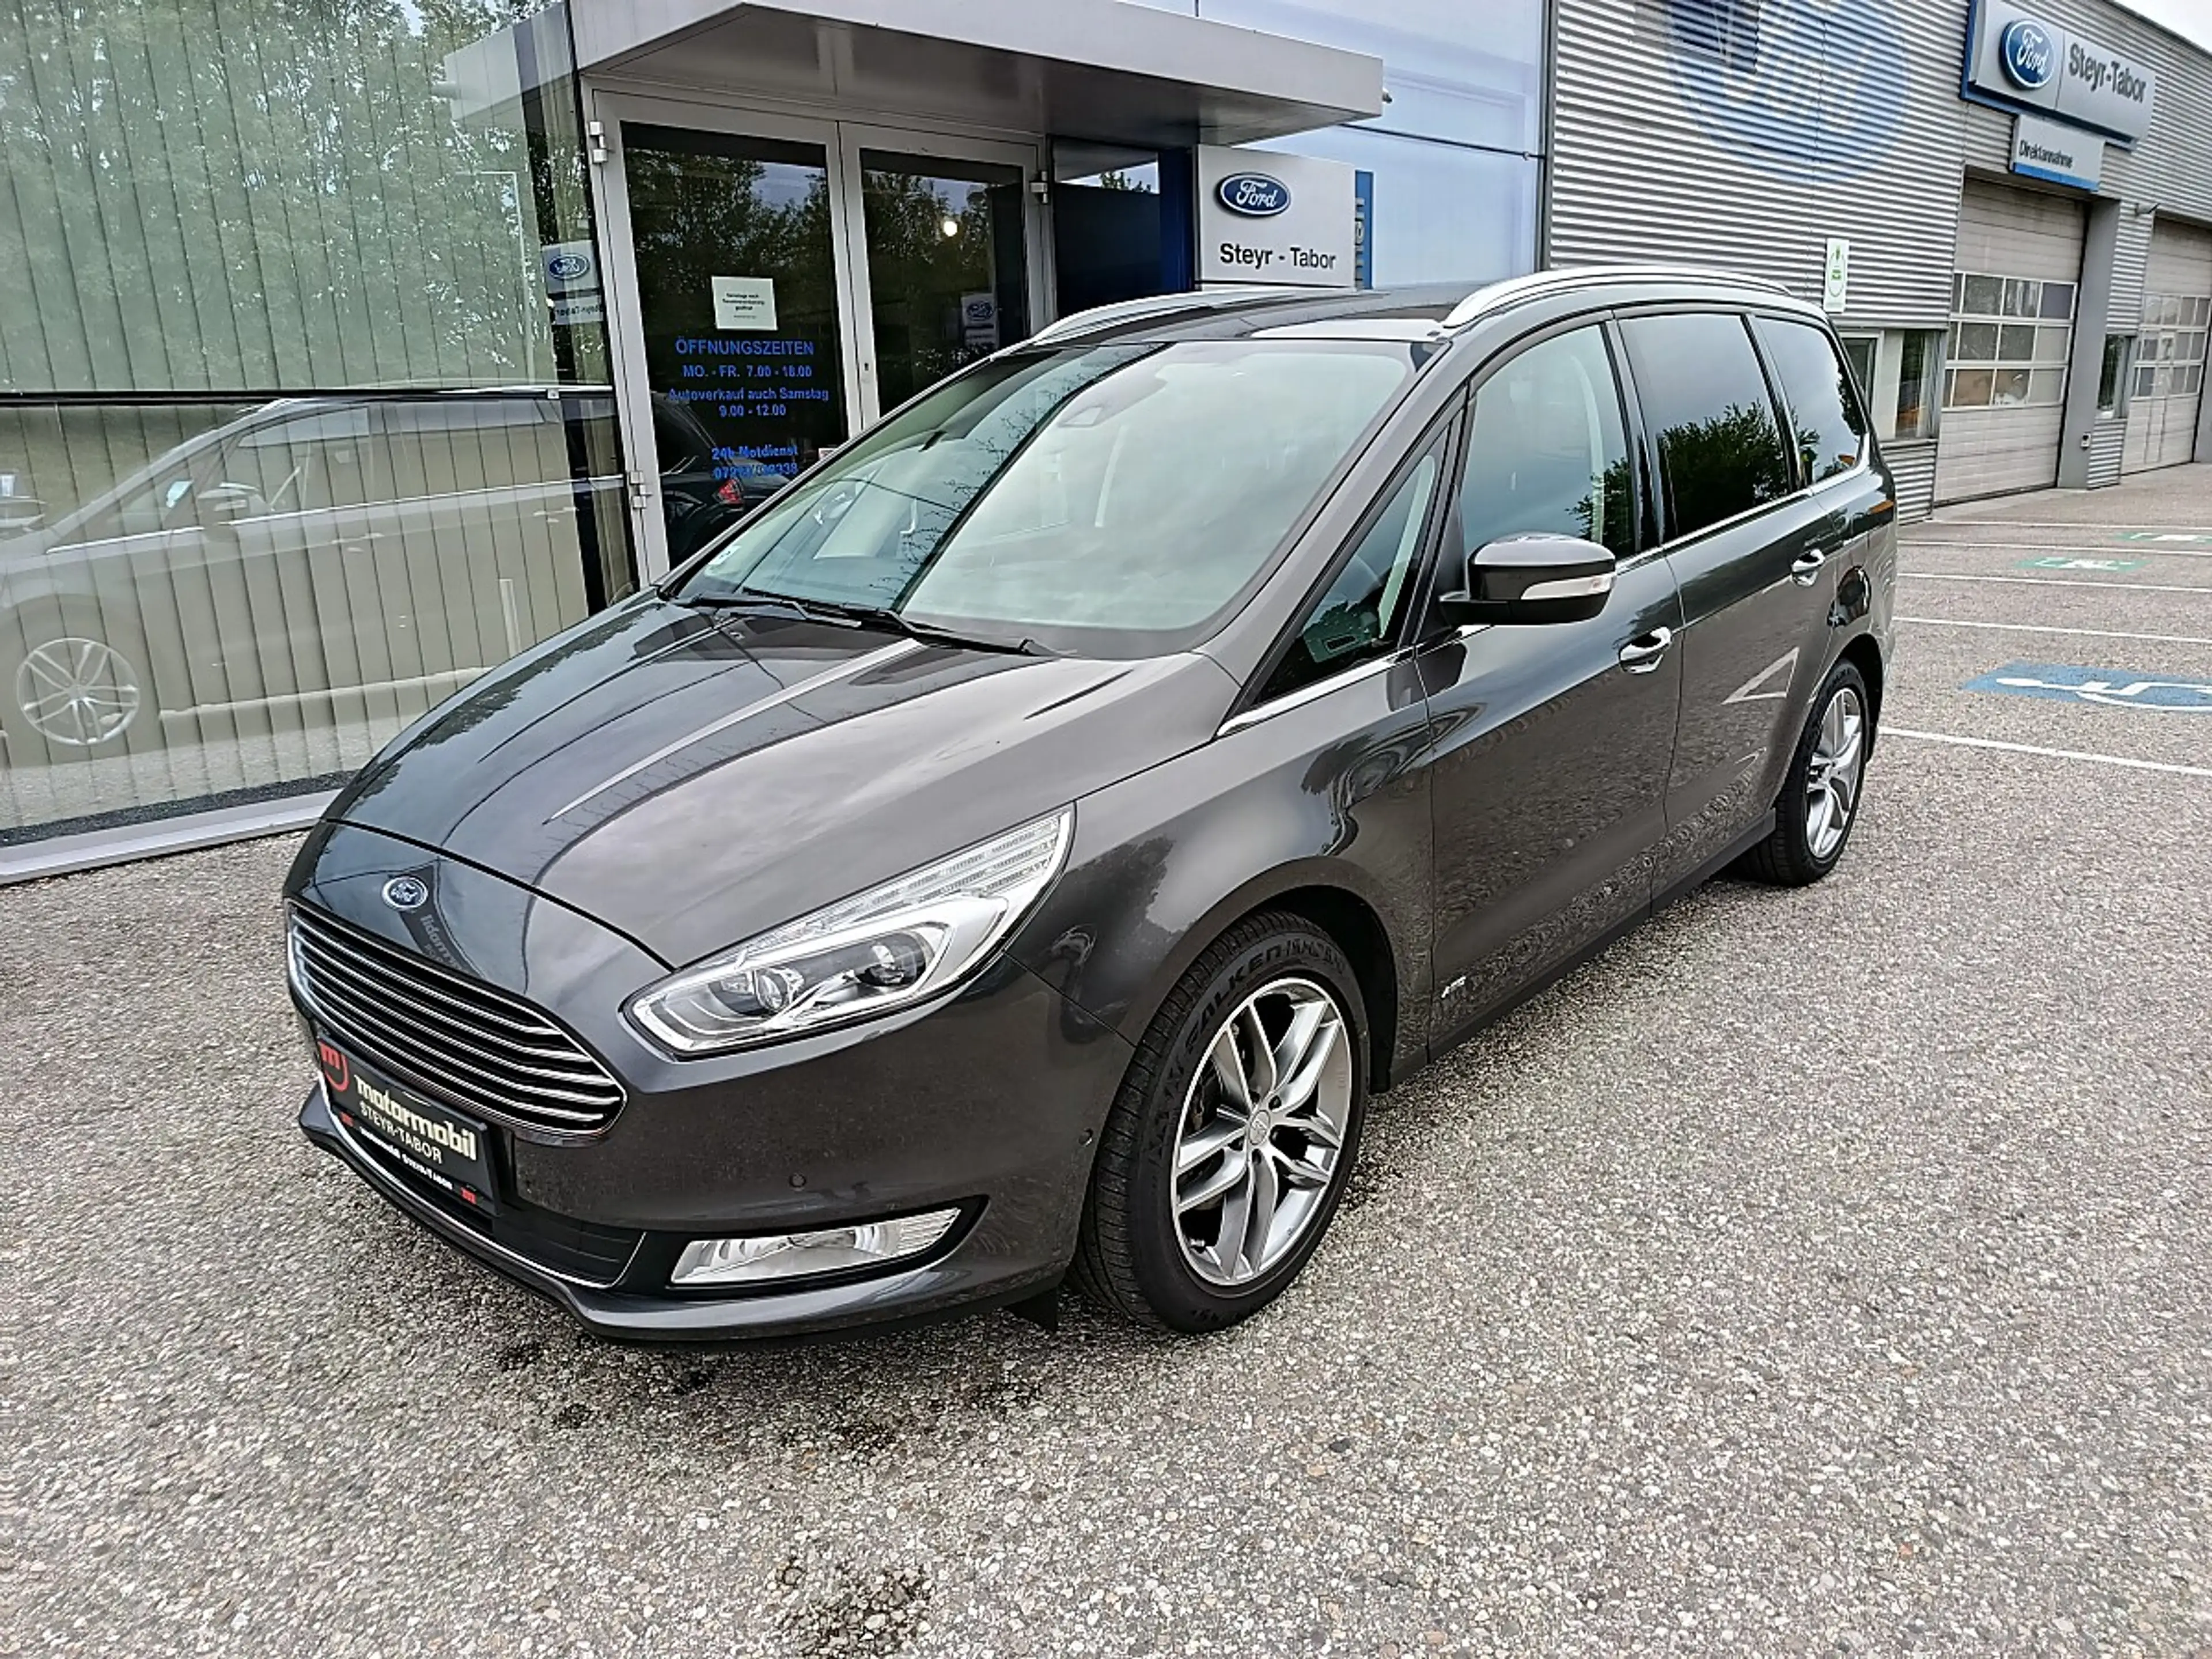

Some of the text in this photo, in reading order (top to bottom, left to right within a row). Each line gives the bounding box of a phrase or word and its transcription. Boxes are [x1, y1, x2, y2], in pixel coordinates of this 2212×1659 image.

[2017, 29, 2049, 74] Ford
[2069, 43, 2147, 103] Steyr-Tabor
[1236, 179, 1278, 208] Ford
[1220, 243, 1273, 270] Steyr
[1290, 247, 1336, 270] Tabor
[675, 336, 814, 355] ÖFFNUNGSZEITEN
[683, 365, 708, 377] MO.
[720, 365, 740, 377] FR.
[746, 365, 771, 377] 7.00
[668, 387, 829, 402] Autoverkauf auch Samstag
[719, 406, 744, 417] 9.00
[756, 404, 786, 415] 12.00
[354, 1074, 477, 1161] motormobil
[359, 1100, 442, 1165] STEYR-TABOR
